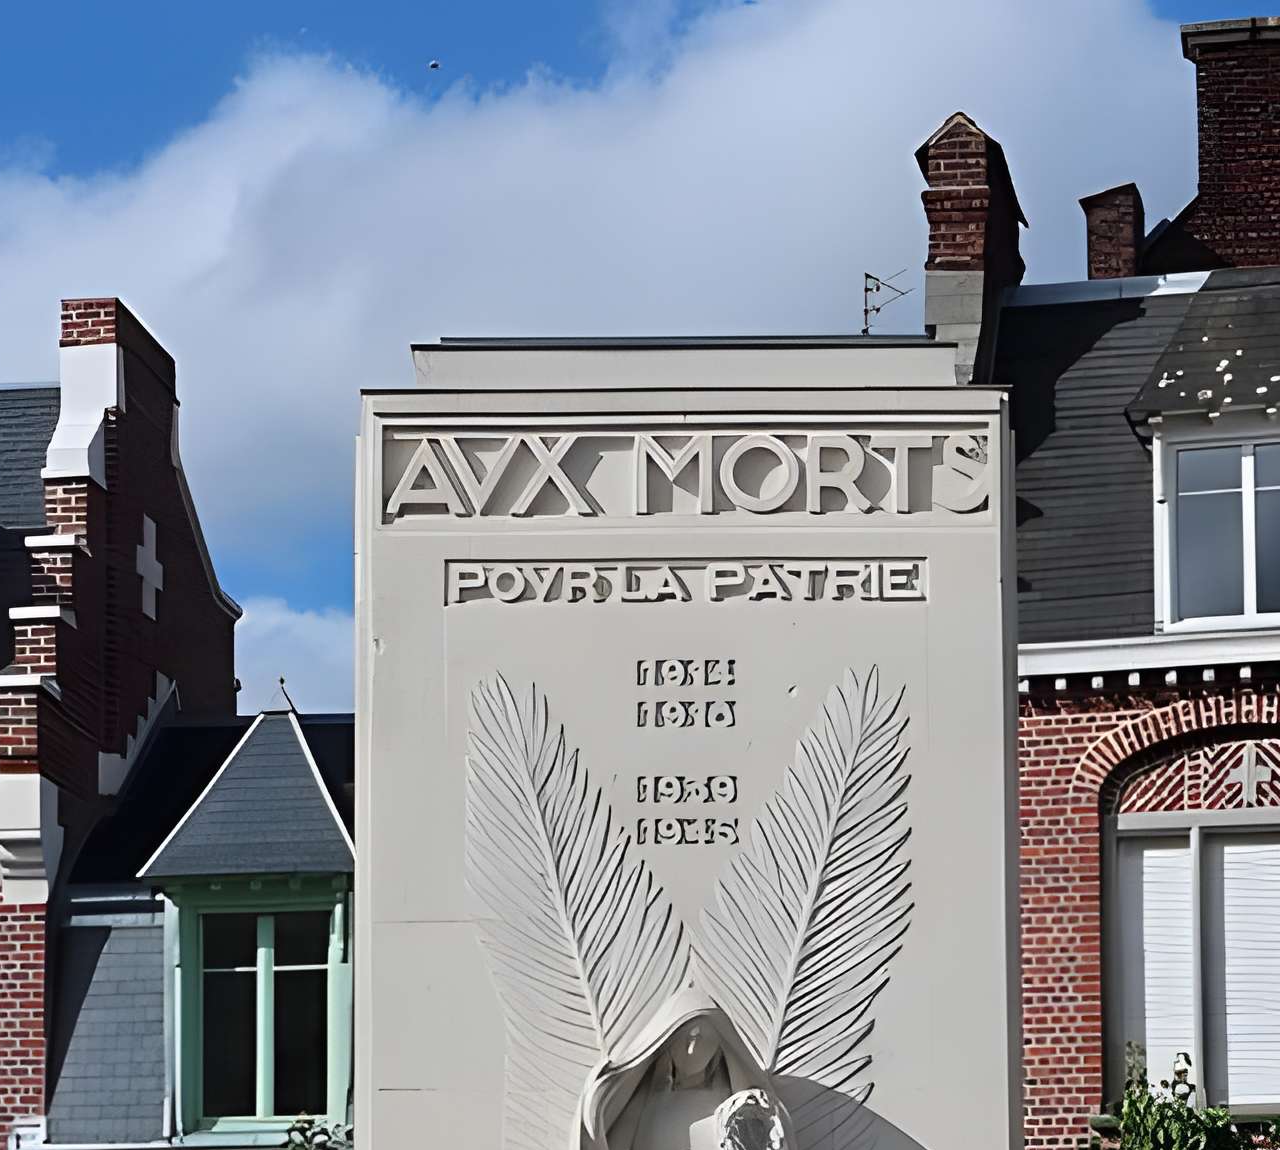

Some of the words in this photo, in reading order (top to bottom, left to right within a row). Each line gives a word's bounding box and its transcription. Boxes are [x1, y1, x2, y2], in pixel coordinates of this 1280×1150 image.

[386, 433, 600, 518] AVX
[634, 432, 991, 517] MORTS
[620, 562, 690, 602] LA
[710, 561, 923, 603] PATRIE
